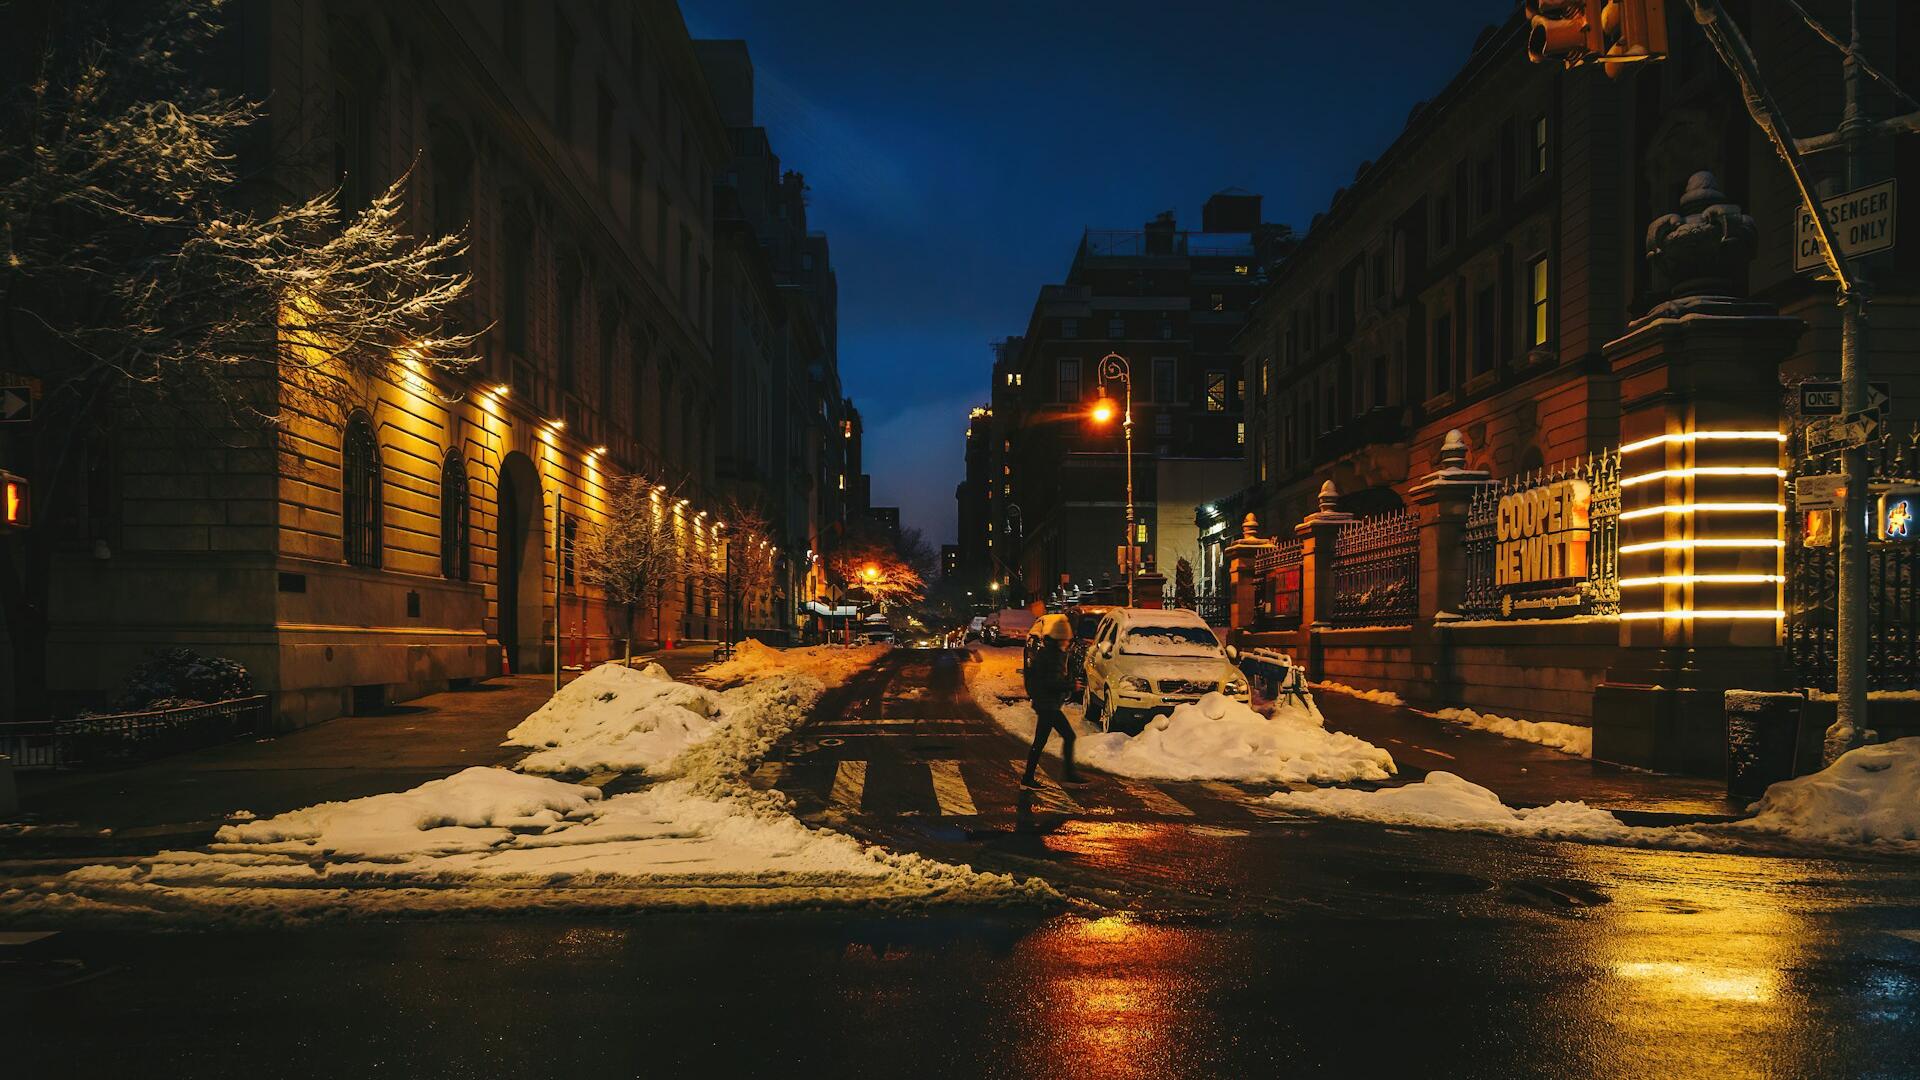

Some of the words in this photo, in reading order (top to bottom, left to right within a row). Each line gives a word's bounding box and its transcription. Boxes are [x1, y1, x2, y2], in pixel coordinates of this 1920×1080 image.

[1802, 192, 1888, 232] PSENGER
[1801, 231, 1839, 257] CA
[1850, 218, 1887, 244] ONLY
[1808, 393, 1834, 405] ONE
[1497, 480, 1576, 542] COOPER
[1495, 530, 1574, 586] HEWITT
